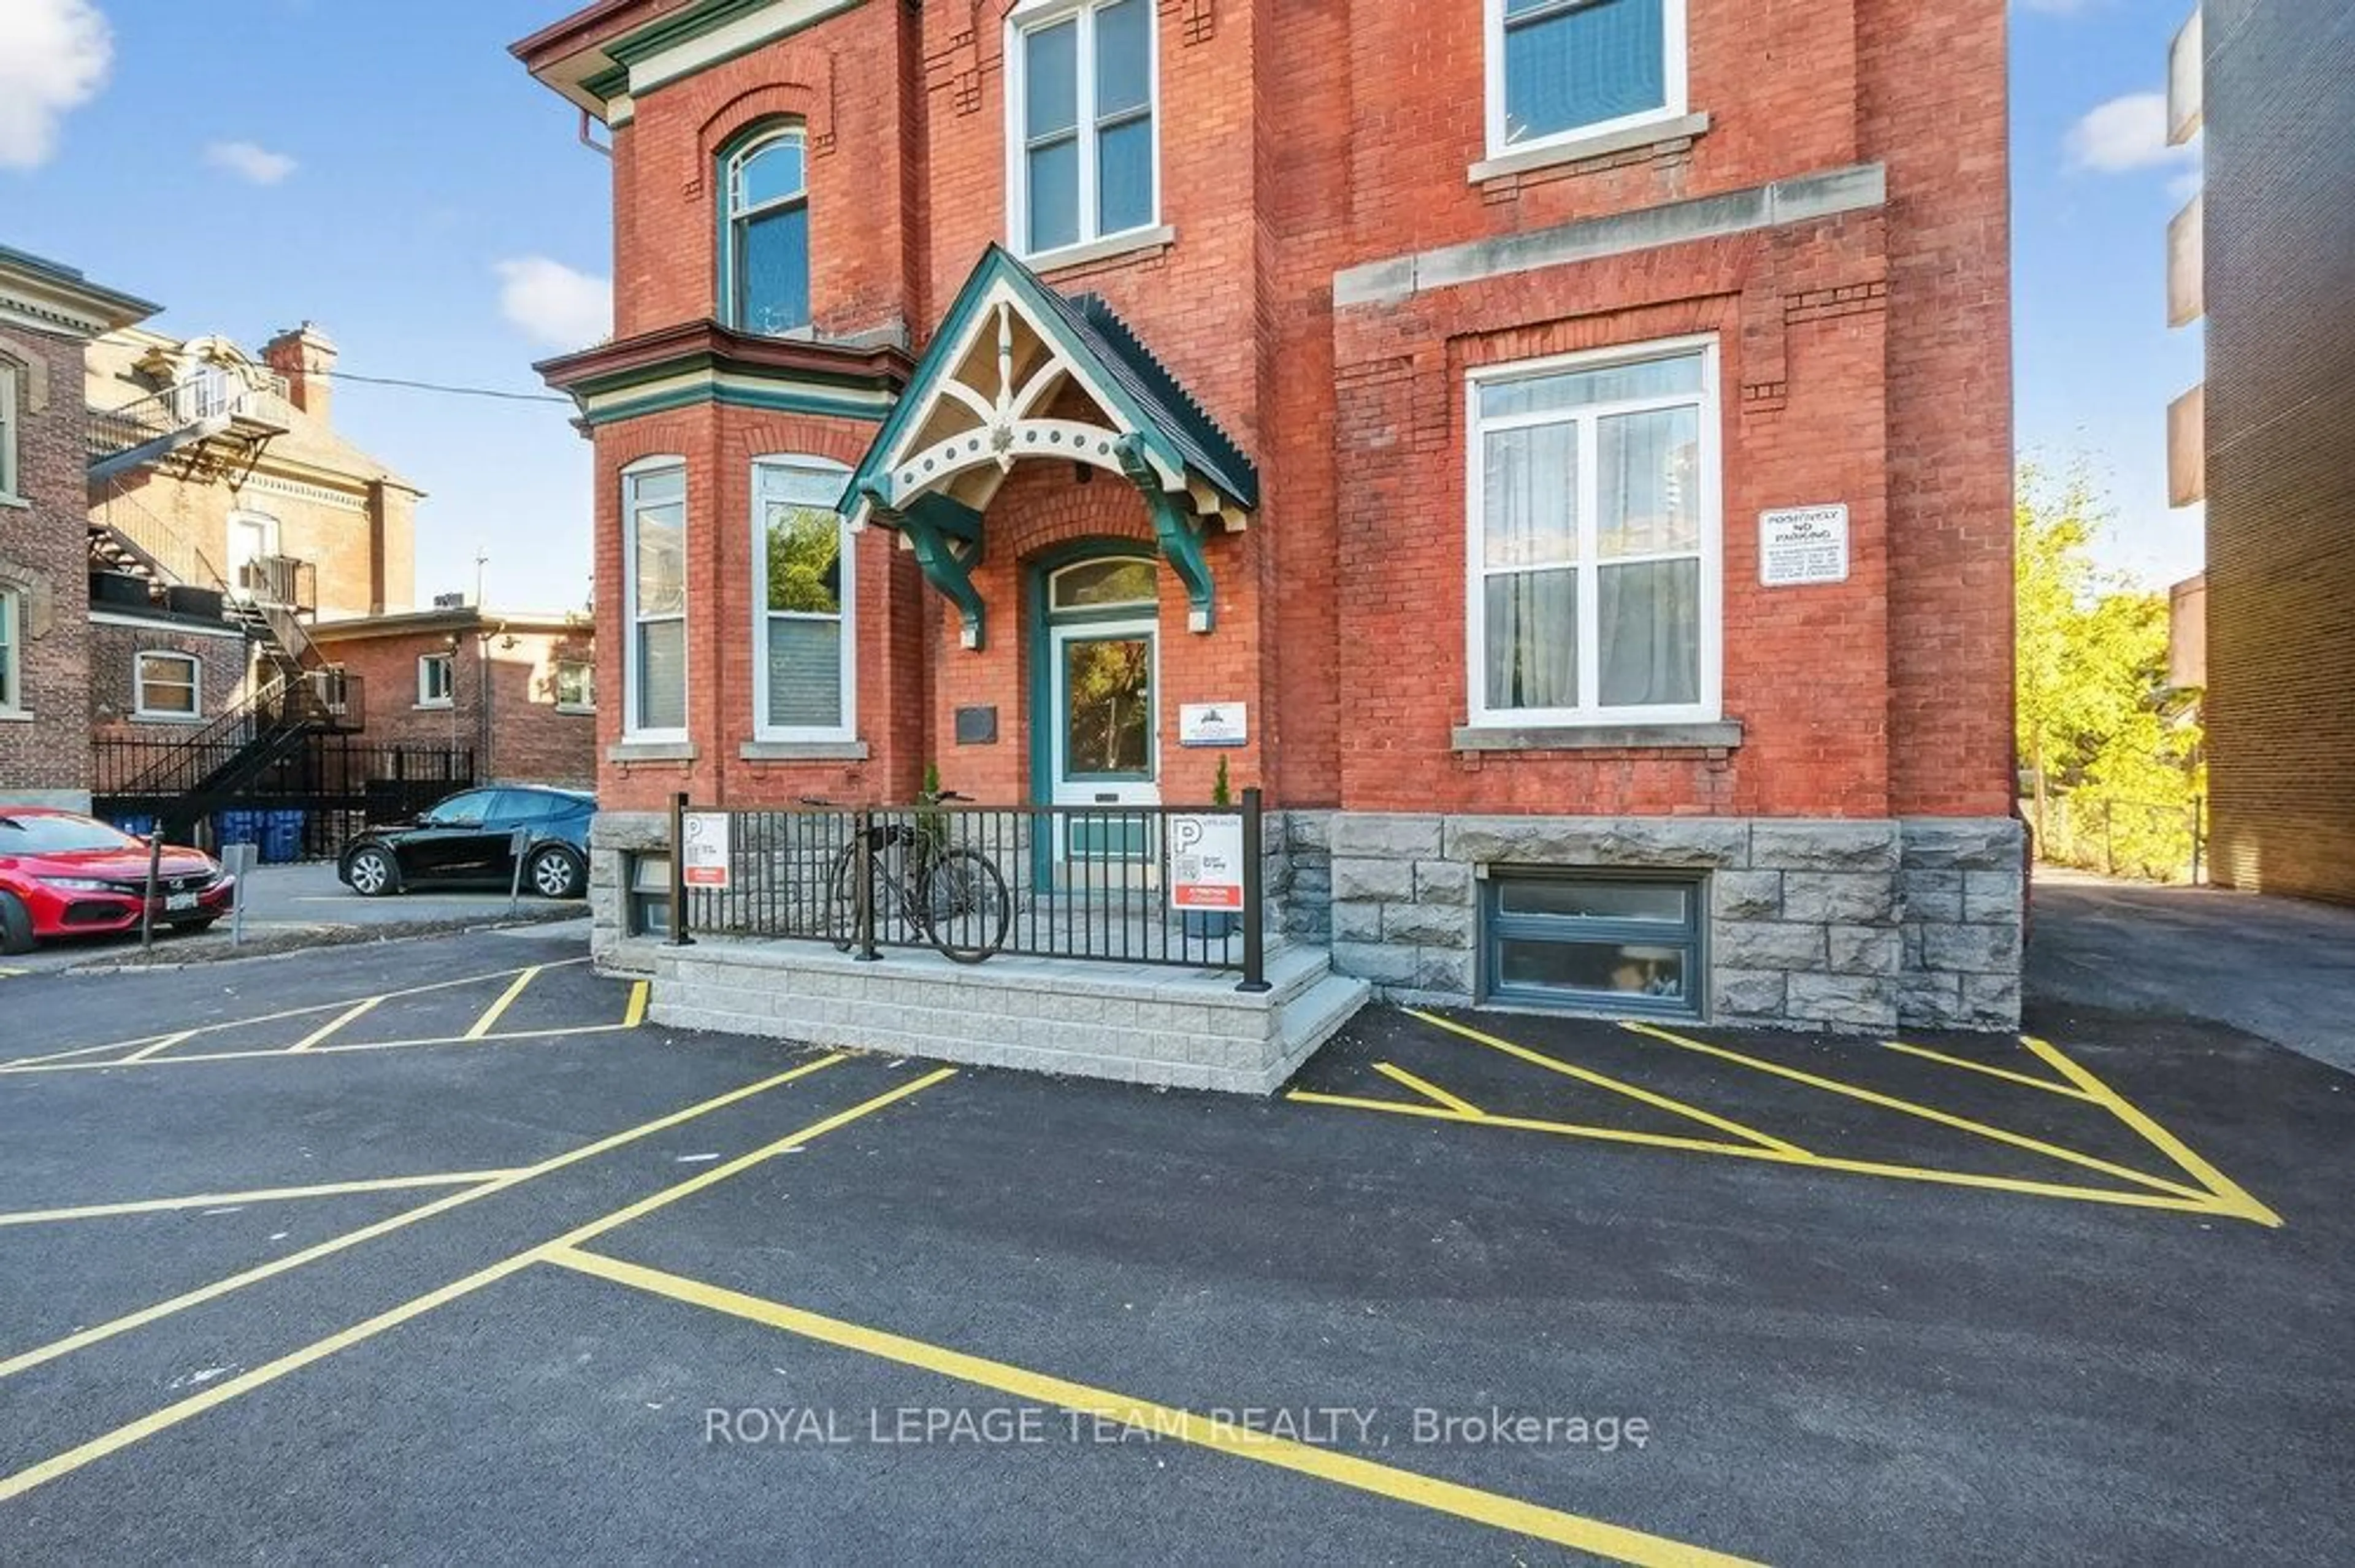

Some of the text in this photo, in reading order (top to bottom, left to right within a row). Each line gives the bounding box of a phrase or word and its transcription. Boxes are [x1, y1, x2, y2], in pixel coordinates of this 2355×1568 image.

[1768, 511, 1838, 524] POSITIVELY
[1793, 522, 1812, 531] NO
[1775, 530, 1831, 542] PARKING
[1173, 817, 1203, 854] P
